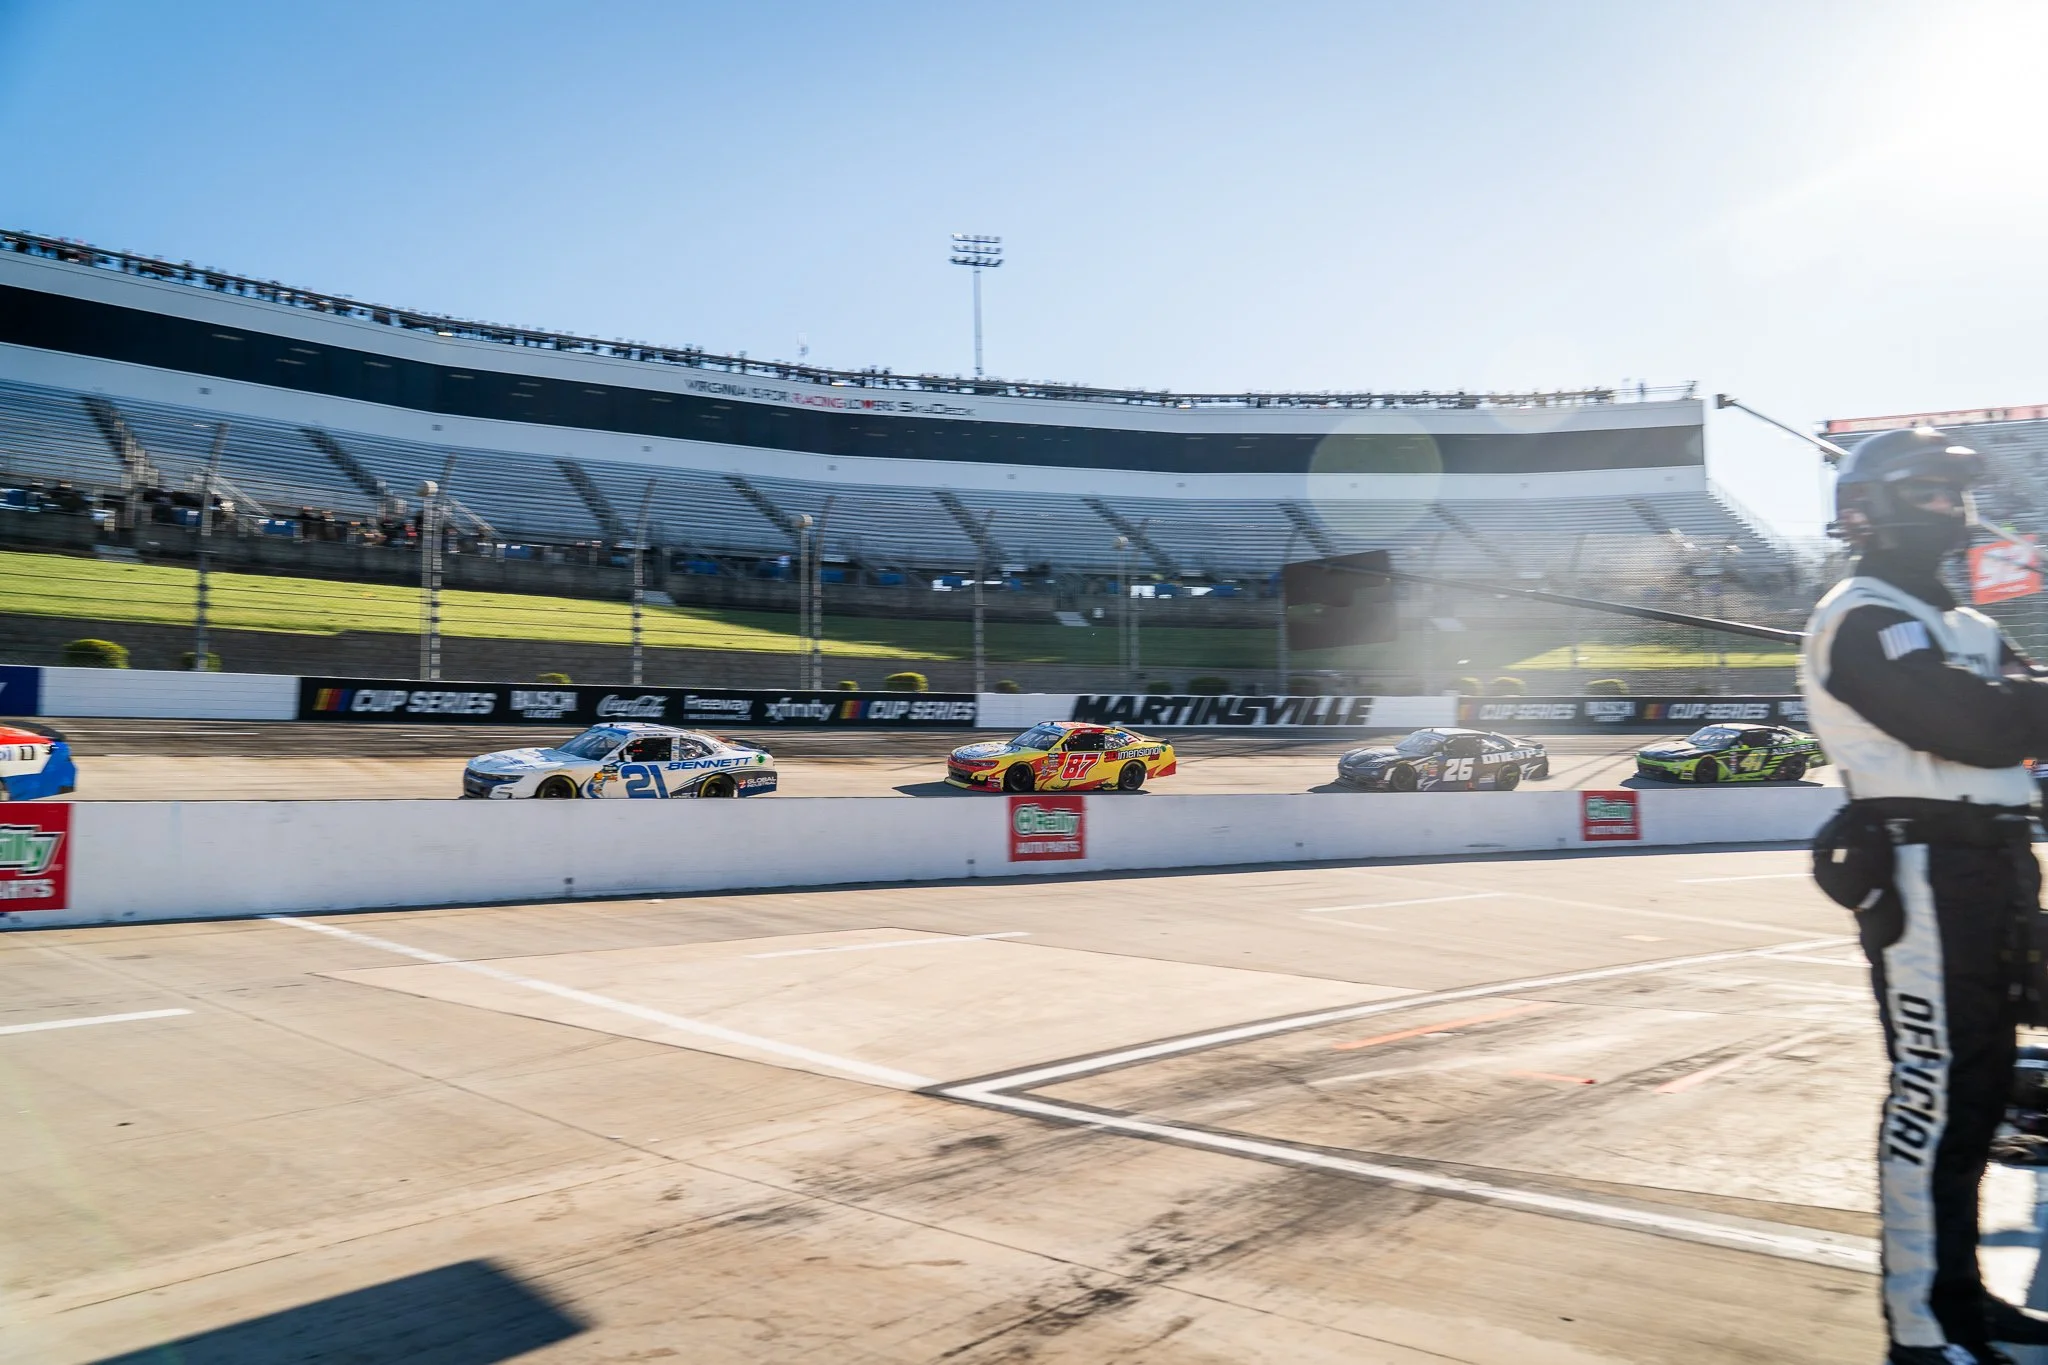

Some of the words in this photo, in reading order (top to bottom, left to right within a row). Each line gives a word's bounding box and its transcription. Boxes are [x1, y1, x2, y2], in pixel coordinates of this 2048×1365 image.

[351, 690, 408, 712] CUP
[406, 691, 497, 714] SERIES
[511, 691, 578, 711] BUSCH
[764, 697, 836, 722] xfinity
[867, 701, 909, 719] CUP
[908, 702, 976, 720] SERIES
[1074, 696, 1377, 725] MARTINSVILLE
[1667, 704, 1705, 719] CUP
[1704, 704, 1770, 720] SERIES
[666, 757, 752, 770] BENNETT
[1061, 753, 1101, 780] 87
[1443, 758, 1475, 781] 26
[621, 764, 670, 798] 21
[747, 776, 776, 784] GLOBAL
[1889, 993, 1942, 1166] OFFICIAL
